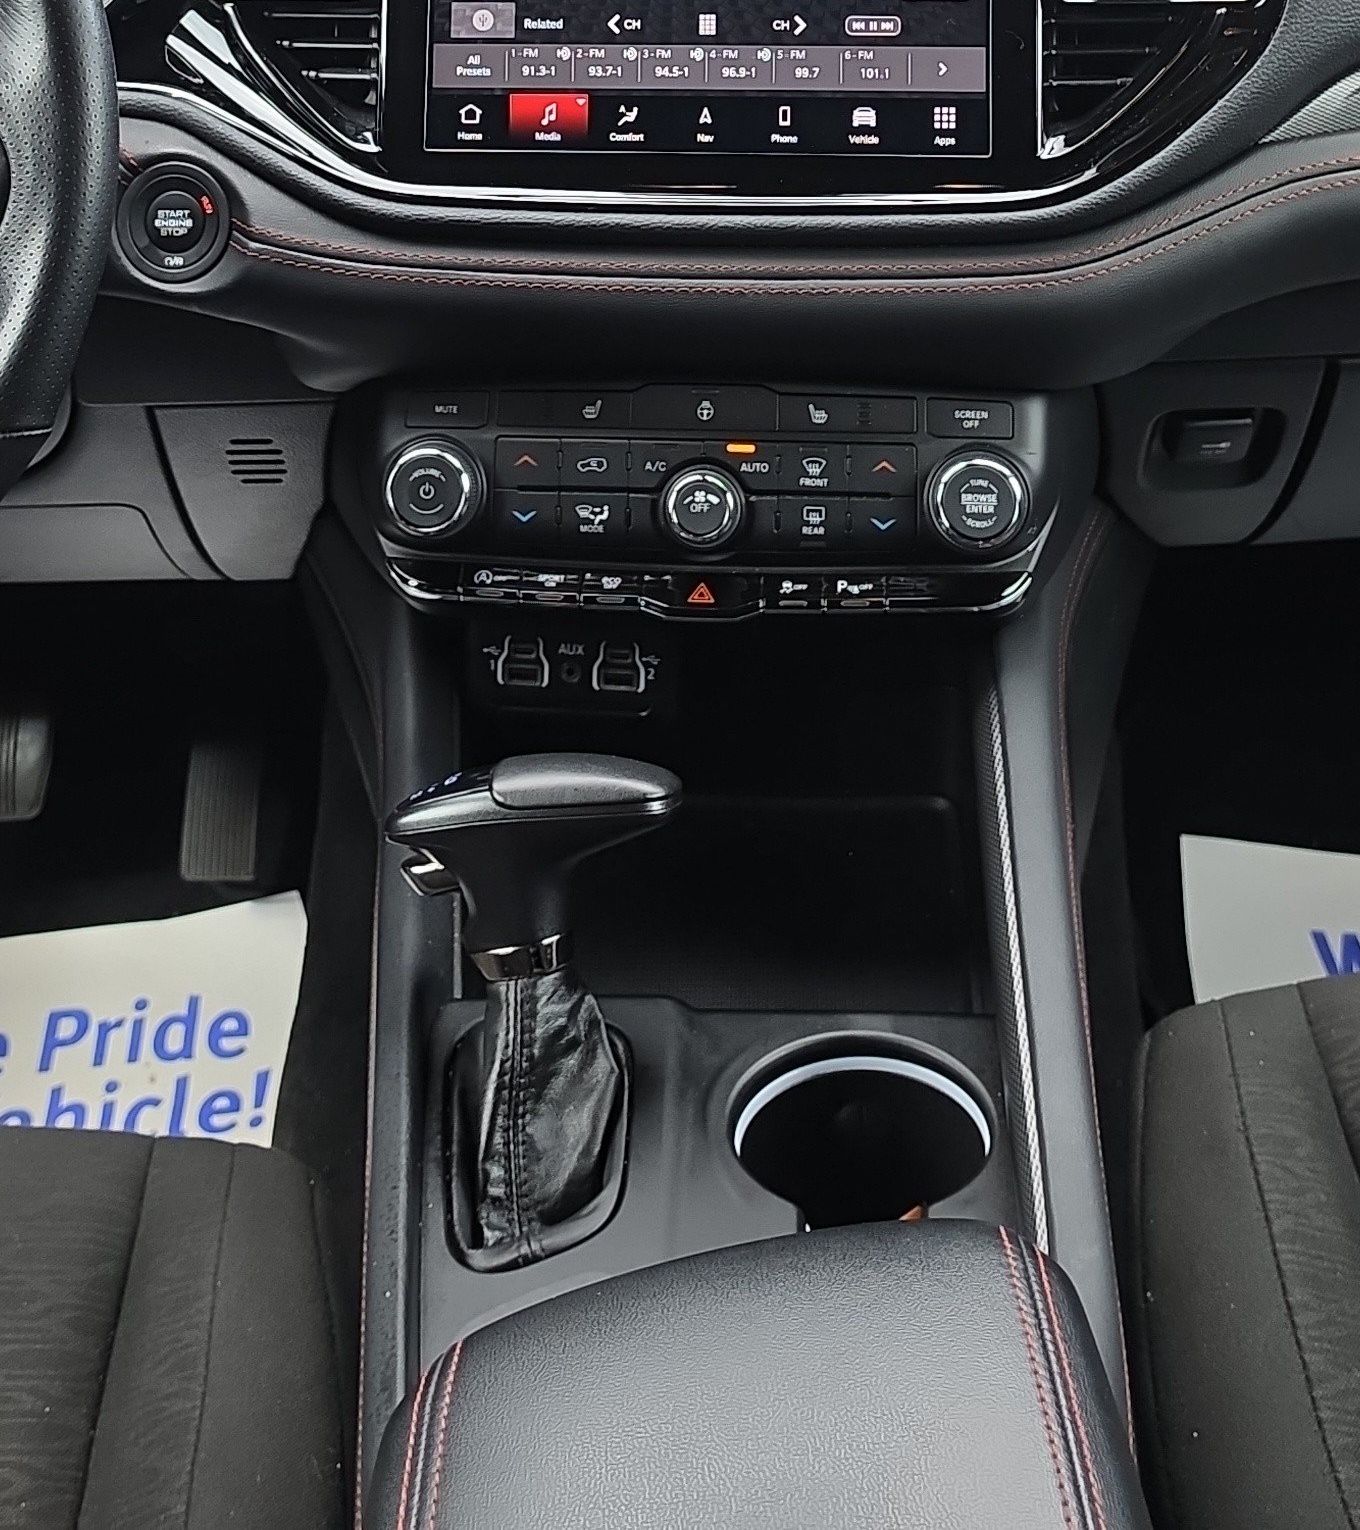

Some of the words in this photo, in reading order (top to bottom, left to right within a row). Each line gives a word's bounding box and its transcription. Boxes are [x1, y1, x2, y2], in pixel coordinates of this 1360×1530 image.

[523, 17, 565, 31] Related
[623, 18, 642, 31] CH
[771, 19, 790, 32] CH
[466, 54, 481, 66] All
[455, 66, 492, 77] Presets
[521, 65, 556, 77] 91.3-1
[588, 65, 623, 78] 93.7-1
[654, 66, 690, 78] 94.5-1
[721, 67, 757, 79] 96.9-1
[794, 67, 820, 79] 99.7
[859, 67, 890, 80] 101.1
[457, 131, 483, 141] Home
[535, 131, 561, 142] Media
[609, 132, 644, 143] Comfort
[696, 132, 715, 144] Nav
[770, 134, 798, 145] Phone
[848, 134, 880, 146] Vehicle
[934, 135, 956, 148] Apps
[156, 209, 191, 219] START
[153, 218, 194, 228] ENGINE
[159, 227, 189, 237] STOP
[434, 404, 459, 415] MUTE
[953, 409, 989, 420] SCREEN
[962, 420, 980, 430] OFF
[644, 460, 667, 472] A/C
[740, 462, 770, 473] AUTO
[799, 477, 829, 488] FRONT
[960, 493, 998, 503] BROWSE
[689, 503, 711, 514] OFF
[965, 504, 995, 514] ENTER
[579, 523, 605, 534] MODE
[965, 517, 994, 529] SCROLL
[801, 526, 825, 536] REAR
[557, 642, 585, 656] AUX
[646, 667, 656, 681] 2
[39, 994, 252, 1075] Pride
